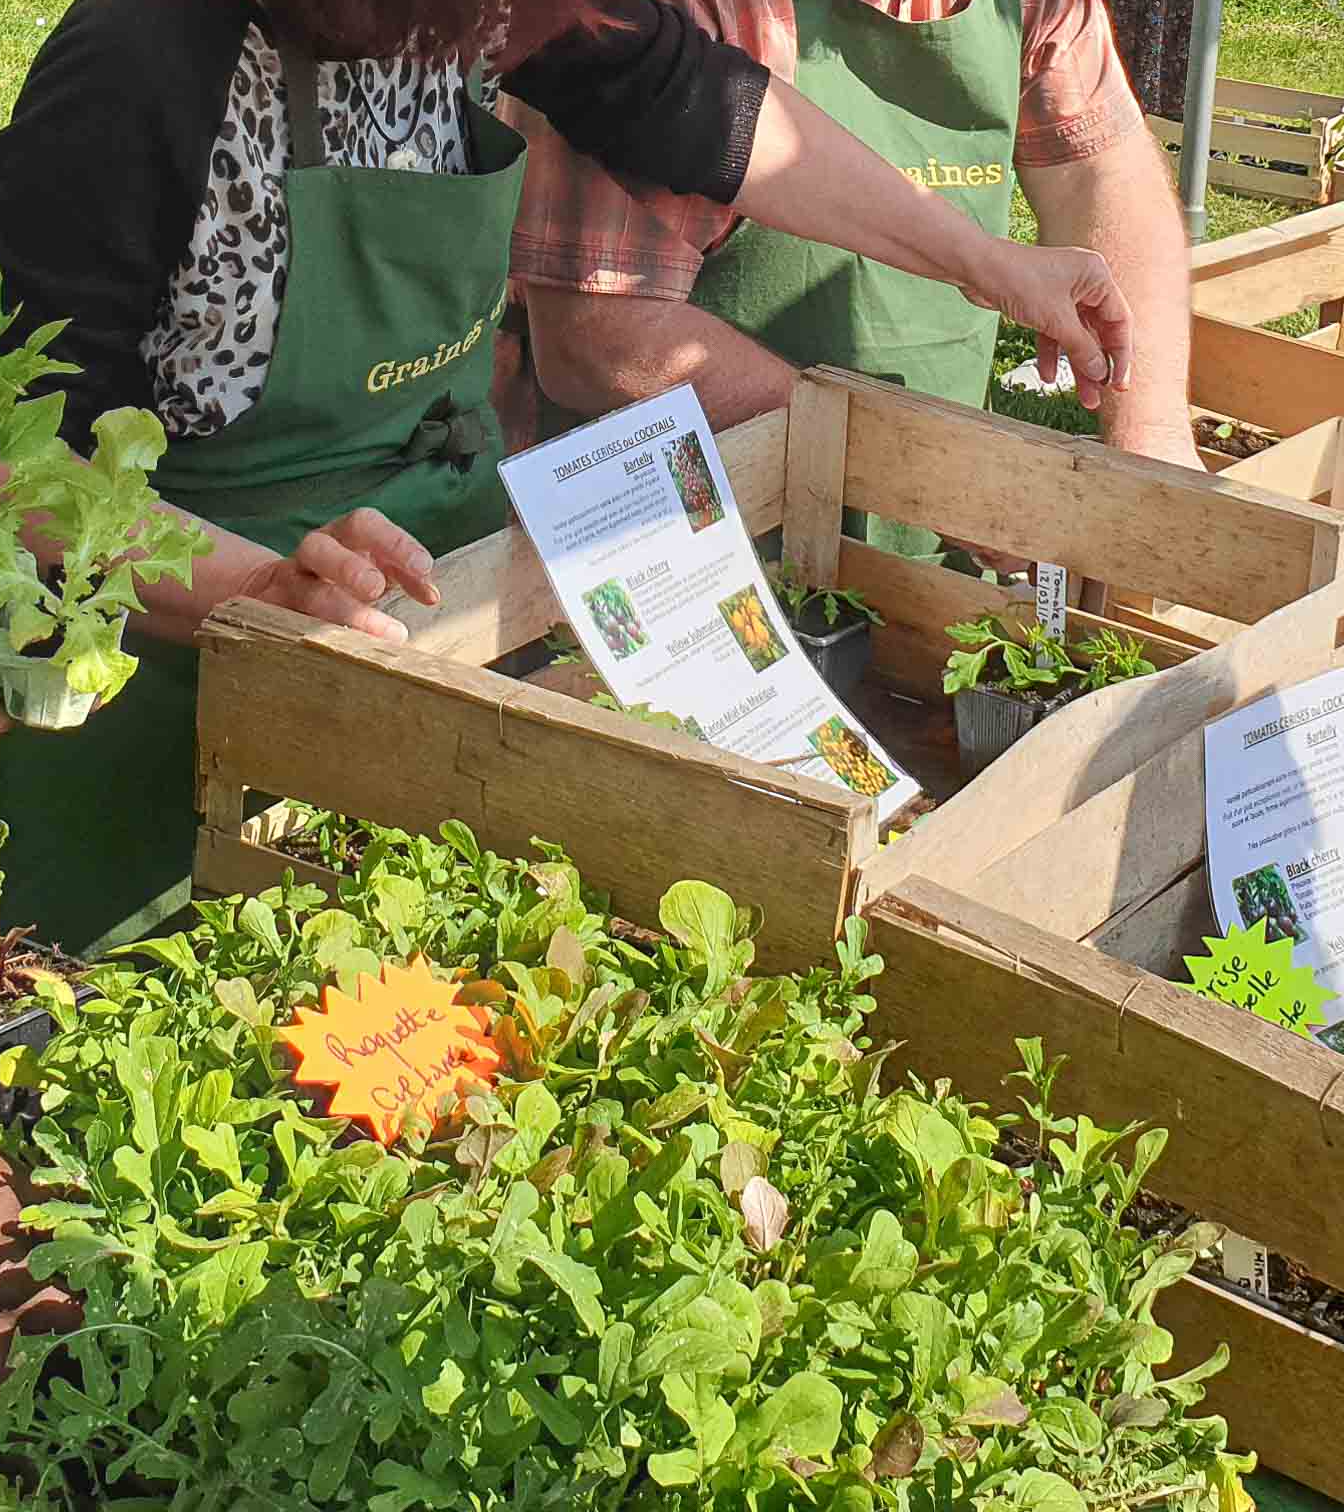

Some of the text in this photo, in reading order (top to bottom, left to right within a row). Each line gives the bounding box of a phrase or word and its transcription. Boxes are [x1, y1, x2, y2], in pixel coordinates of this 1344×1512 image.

[896, 158, 1003, 186] aines
[367, 318, 486, 393] Graines
[552, 453, 593, 480] TOMATES
[591, 440, 624, 467] CERISES
[634, 415, 676, 443] COCKTAILS
[622, 450, 656, 474] Bartelly
[1243, 721, 1279, 747] TOMATES
[1278, 706, 1311, 731] CERISES
[1285, 860, 1311, 879] Black
[1309, 847, 1340, 870] cherry
